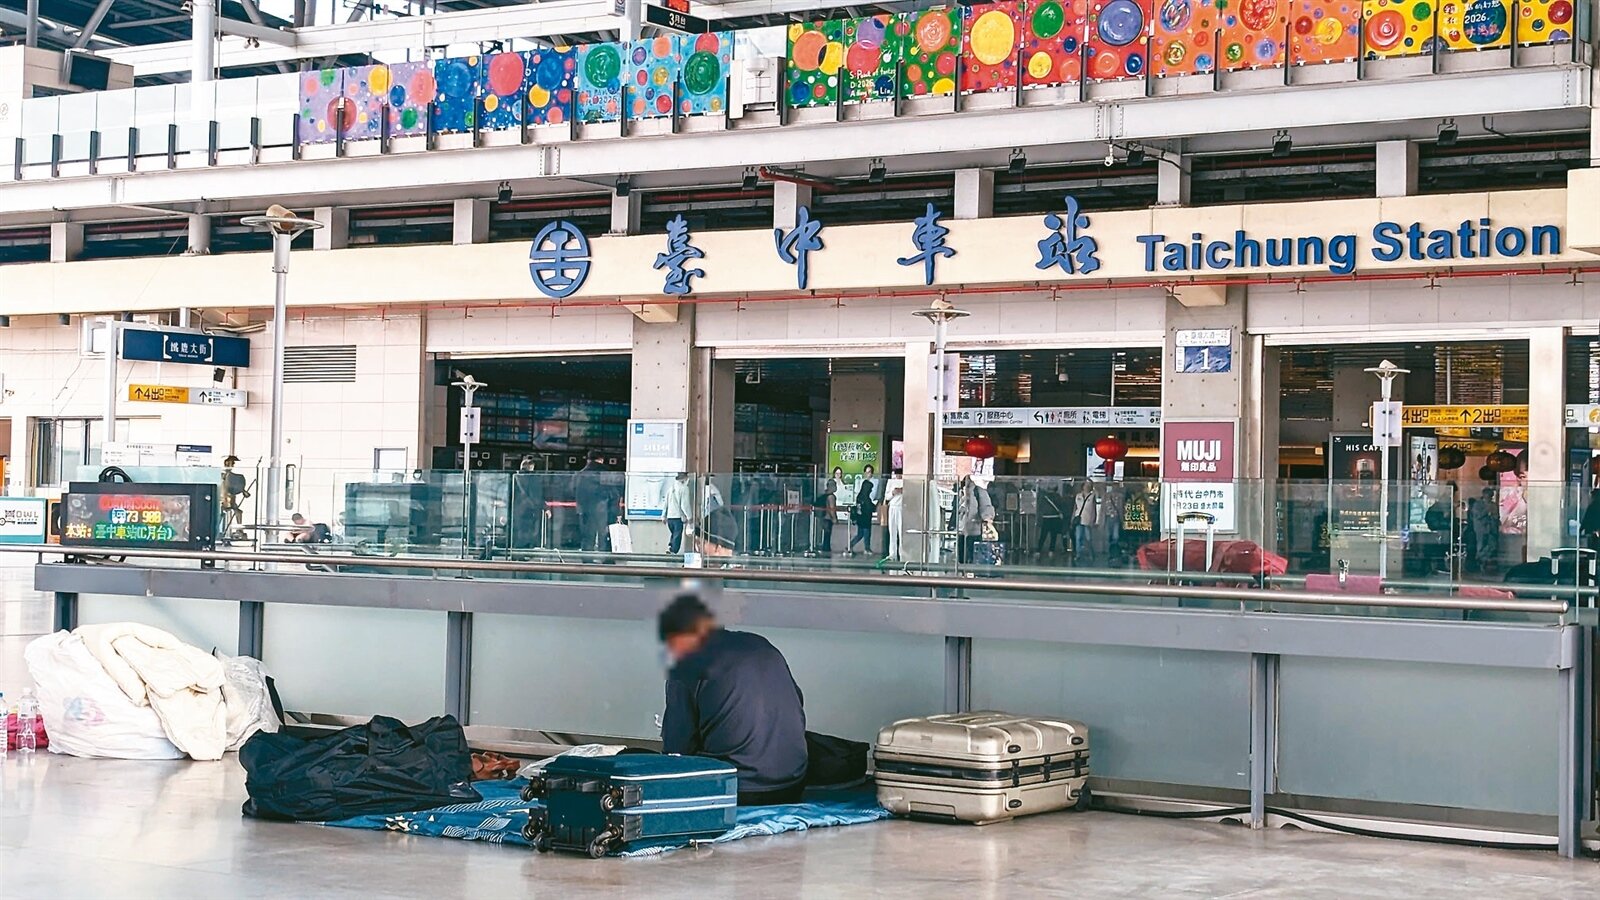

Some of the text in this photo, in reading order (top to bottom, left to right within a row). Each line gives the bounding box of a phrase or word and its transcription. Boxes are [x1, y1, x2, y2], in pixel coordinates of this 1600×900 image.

[653, 196, 1101, 295] 臺中車站
[1137, 217, 1561, 274] Taichung Station
[143, 388, 164, 400] 4出口
[1472, 409, 1501, 423] 2出口
[1177, 440, 1221, 460] MUJI
[1345, 444, 1359, 452] HIS
[1181, 462, 1217, 472] 無印良品
